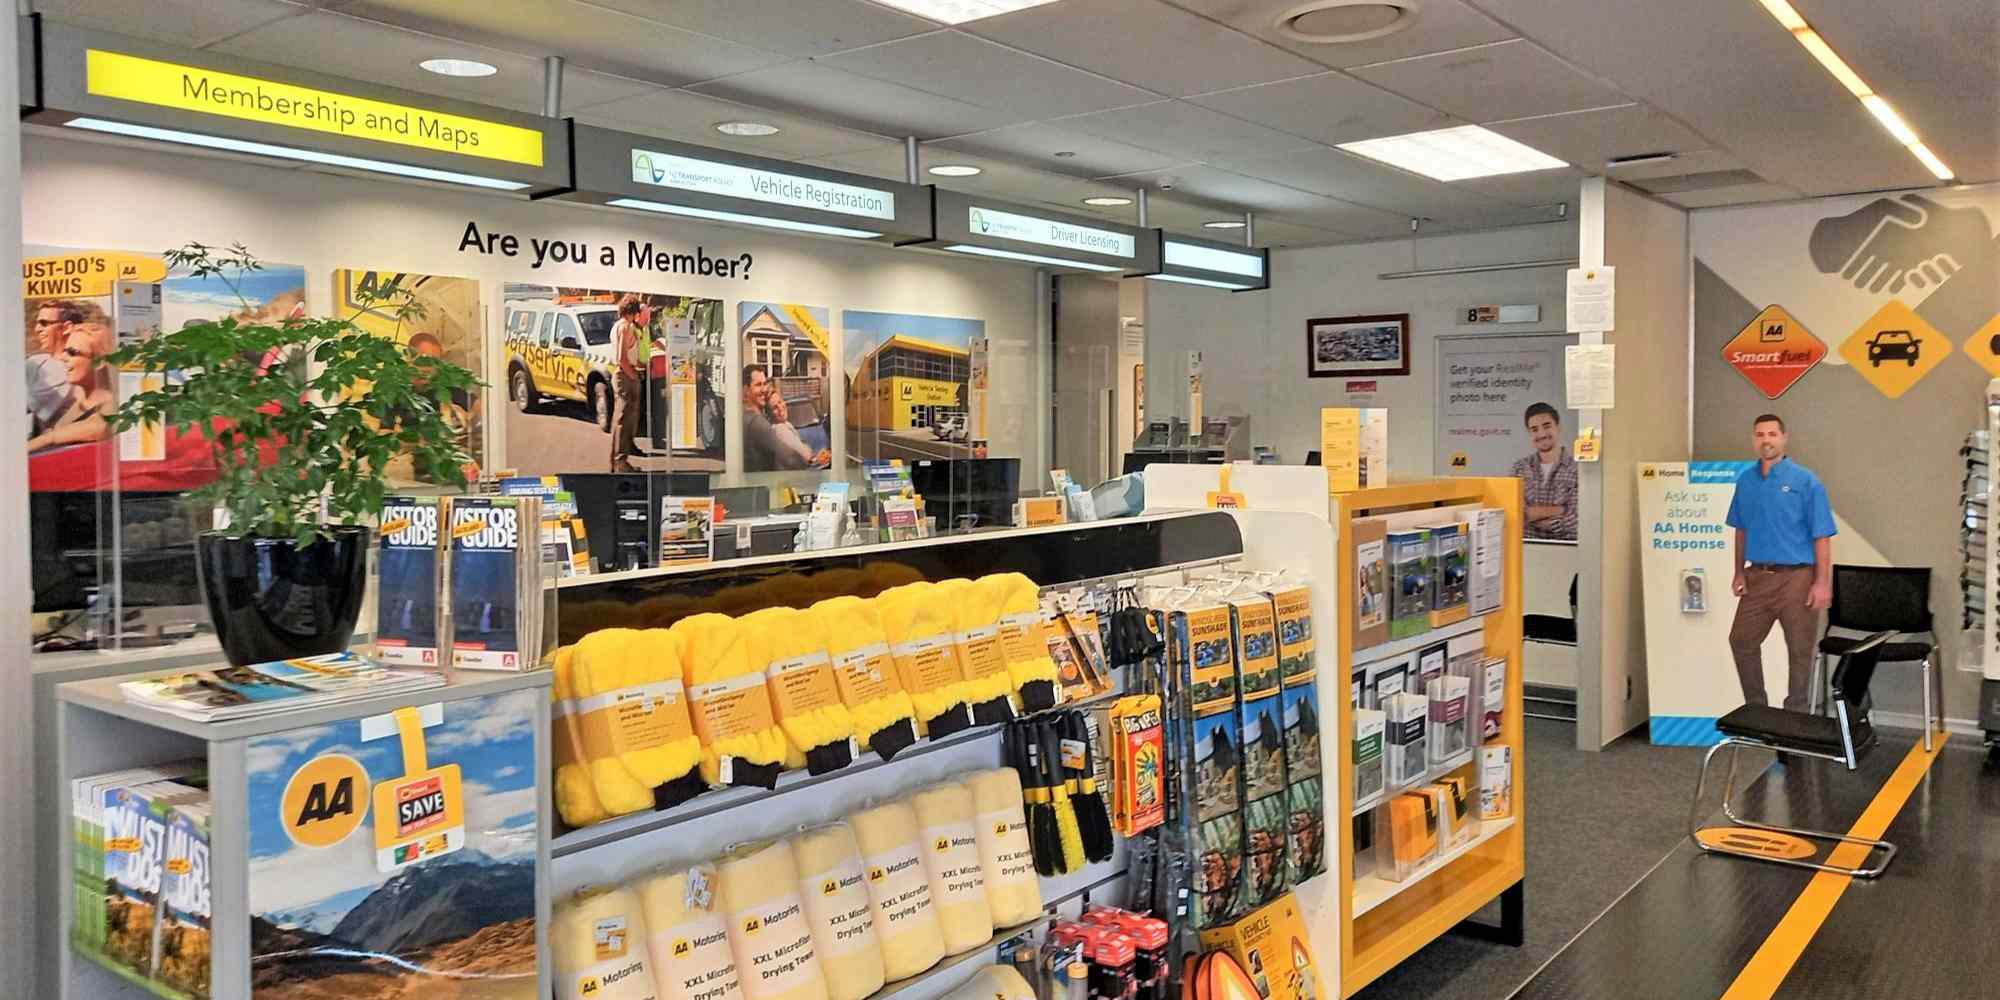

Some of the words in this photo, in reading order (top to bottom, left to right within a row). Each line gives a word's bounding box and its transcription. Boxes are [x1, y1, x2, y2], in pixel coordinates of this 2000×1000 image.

[182, 74, 356, 133] Membership
[365, 112, 409, 135] and
[418, 116, 481, 150] Maps
[750, 175, 803, 199] Vehicle
[805, 183, 883, 212] Registration
[1051, 225, 1079, 244] Driver
[1080, 232, 1120, 254] Licensing
[458, 222, 520, 257] Are
[530, 237, 588, 269] you
[600, 245, 615, 267] a
[627, 240, 754, 280] Member?
[122, 265, 137, 276] AA
[27, 277, 83, 296] KIWIS
[1467, 308, 1478, 322] 8
[1765, 324, 1784, 336] AA
[1731, 349, 1812, 365] Smartfuel
[1449, 364, 1468, 376] Get
[1469, 364, 1494, 377] your
[1449, 378, 1489, 389] verified
[1490, 377, 1534, 391] identity
[1449, 393, 1480, 404] photo
[1482, 393, 1507, 403] here
[1452, 456, 1467, 466] AA
[1643, 469, 1655, 477] AA
[1658, 469, 1685, 477] Home
[1691, 470, 1736, 479] Response
[1664, 491, 1689, 503] Ask
[1692, 493, 1709, 503] us
[1667, 508, 1708, 518] about
[1653, 522, 1675, 534] AA
[1679, 522, 1724, 534] Home
[388, 526, 438, 546] GUIDE
[461, 528, 518, 548] GUIDE
[1653, 538, 1726, 552] Response
[296, 777, 353, 827] AA
[401, 791, 444, 823] SAVE
[996, 825, 1007, 834] AA
[937, 840, 949, 850] AA
[871, 870, 883, 880] AA
[886, 857, 920, 875] Motoring
[942, 869, 958, 879] XXL
[1002, 866, 1025, 876] Drying
[824, 883, 836, 894] AA
[949, 881, 973, 892] Drying
[881, 898, 898, 909] XXL
[830, 915, 848, 926] XXL
[889, 906, 917, 922] Drying
[745, 921, 759, 932] AA
[837, 926, 863, 940] Drying
[1242, 915, 1271, 941] VEHICLE
[674, 941, 688, 955] AA
[753, 952, 773, 966] XXL
[582, 980, 598, 994] AA
[602, 961, 644, 986] Motoring
[762, 962, 795, 980] Drying
[684, 976, 705, 989] XXL
[694, 985, 725, 1000] Drying
